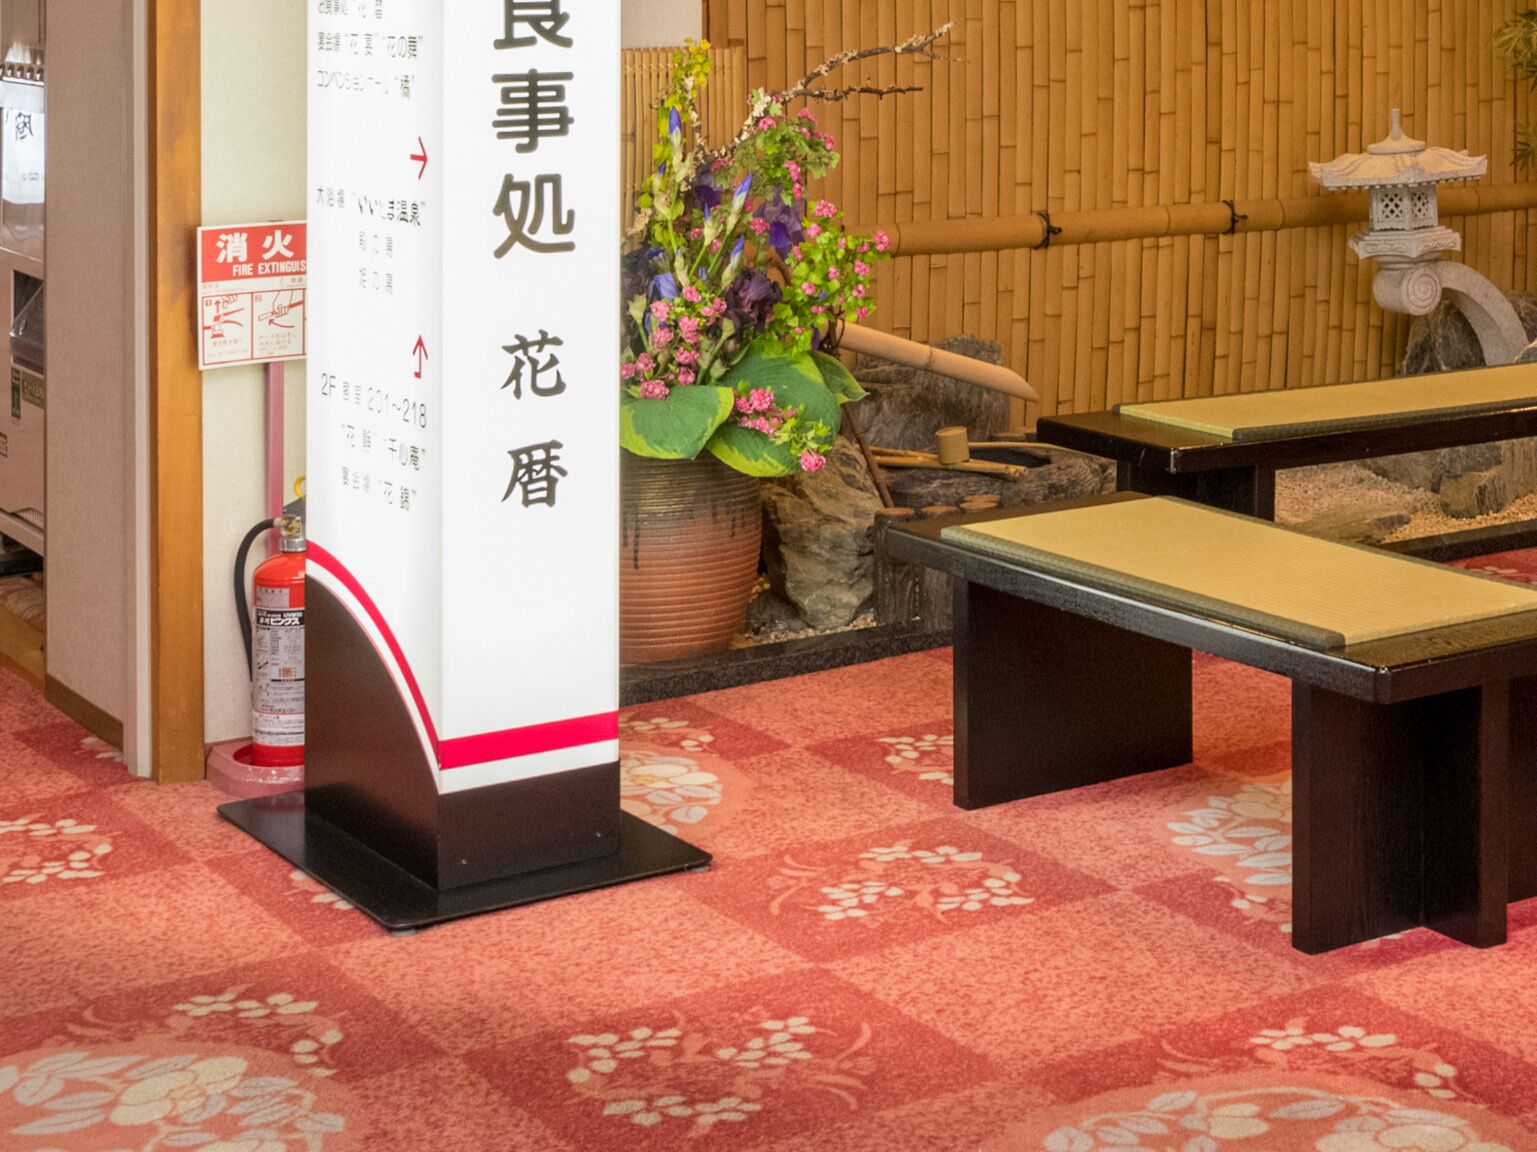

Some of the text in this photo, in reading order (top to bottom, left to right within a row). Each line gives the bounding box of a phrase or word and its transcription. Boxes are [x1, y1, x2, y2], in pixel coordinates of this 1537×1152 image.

[216, 229, 295, 264] 消火
[233, 264, 253, 276] FIRE
[321, 372, 337, 398] 2F
[500, 329, 569, 508] 花暦
